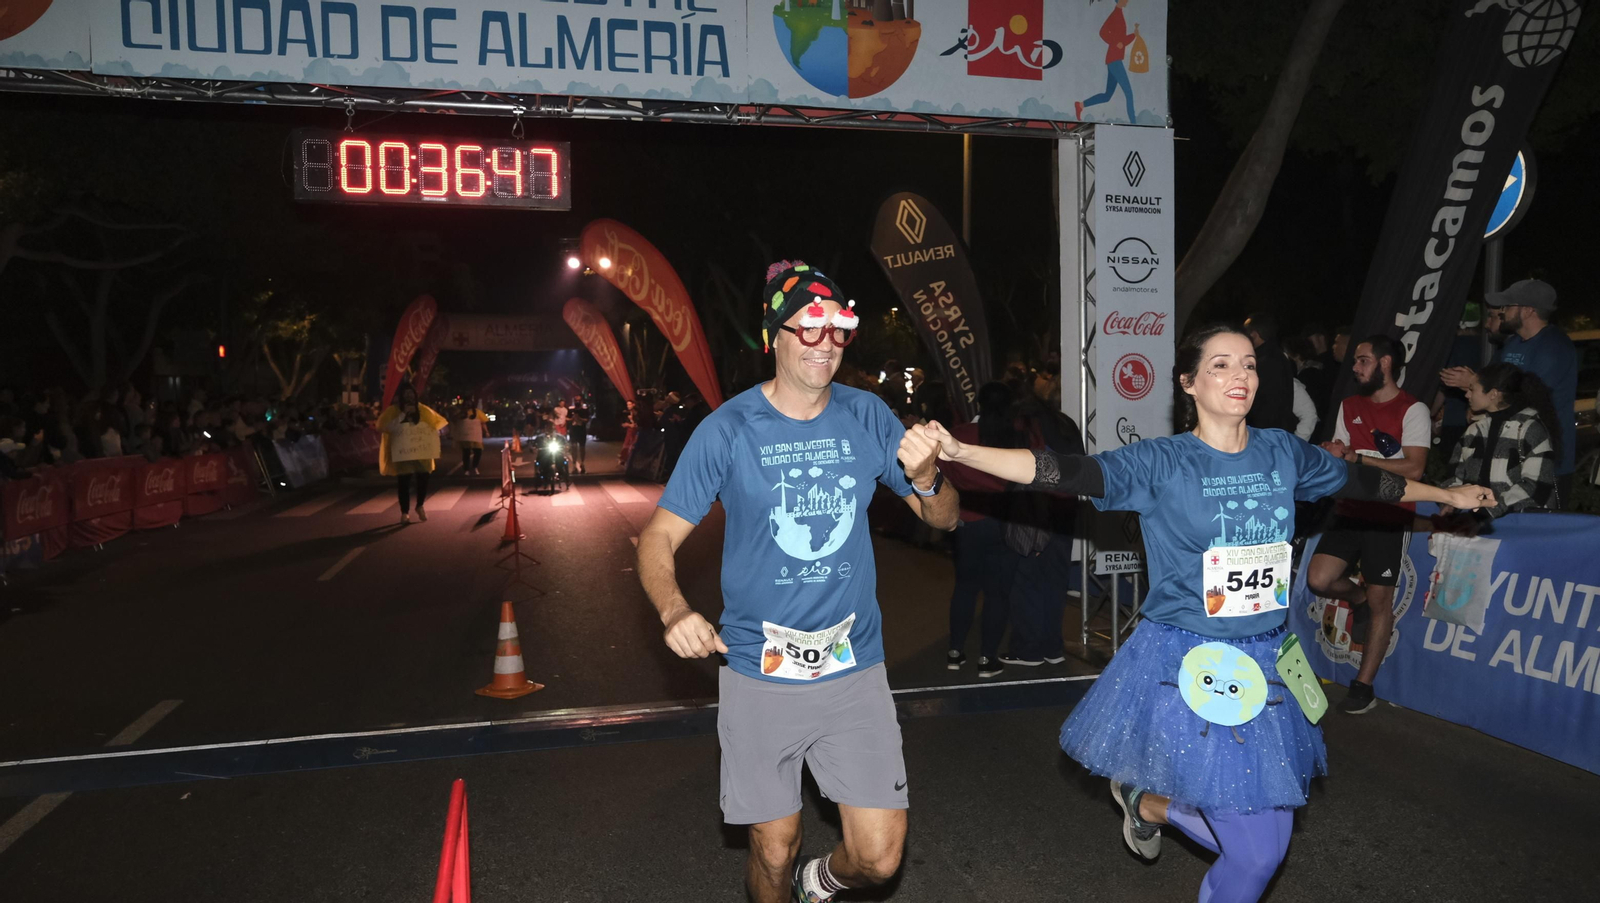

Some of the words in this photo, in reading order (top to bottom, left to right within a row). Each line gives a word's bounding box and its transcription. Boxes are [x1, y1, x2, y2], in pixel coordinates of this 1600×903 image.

[120, 0, 359, 60] CIUDAD
[381, 5, 458, 64] DE
[478, 10, 730, 78] ALMERÍA
[1105, 194, 1162, 206] RENAULT
[1105, 205, 1123, 213] SYRSA
[1124, 206, 1162, 214] AUTOMOCION
[1107, 256, 1160, 265] NISSAN
[1112, 285, 1158, 294] andalmotor.es
[1103, 310, 1169, 336] Coca-Cola
[760, 445, 774, 455] XIV
[775, 443, 792, 453] SAN
[793, 438, 836, 451] SILVESTRE
[761, 454, 791, 466] CIUDAD
[792, 453, 804, 463] DE
[804, 448, 839, 461] ALMERÍA
[1227, 486, 1238, 496] DE
[1226, 549, 1239, 557] XIV
[1241, 548, 1256, 556] SAN
[1227, 557, 1254, 565] CIUDAD
[1254, 556, 1263, 564] DE
[1226, 567, 1274, 592] 545
[1486, 571, 1600, 630] YUNT
[1488, 629, 1600, 695] ALM
